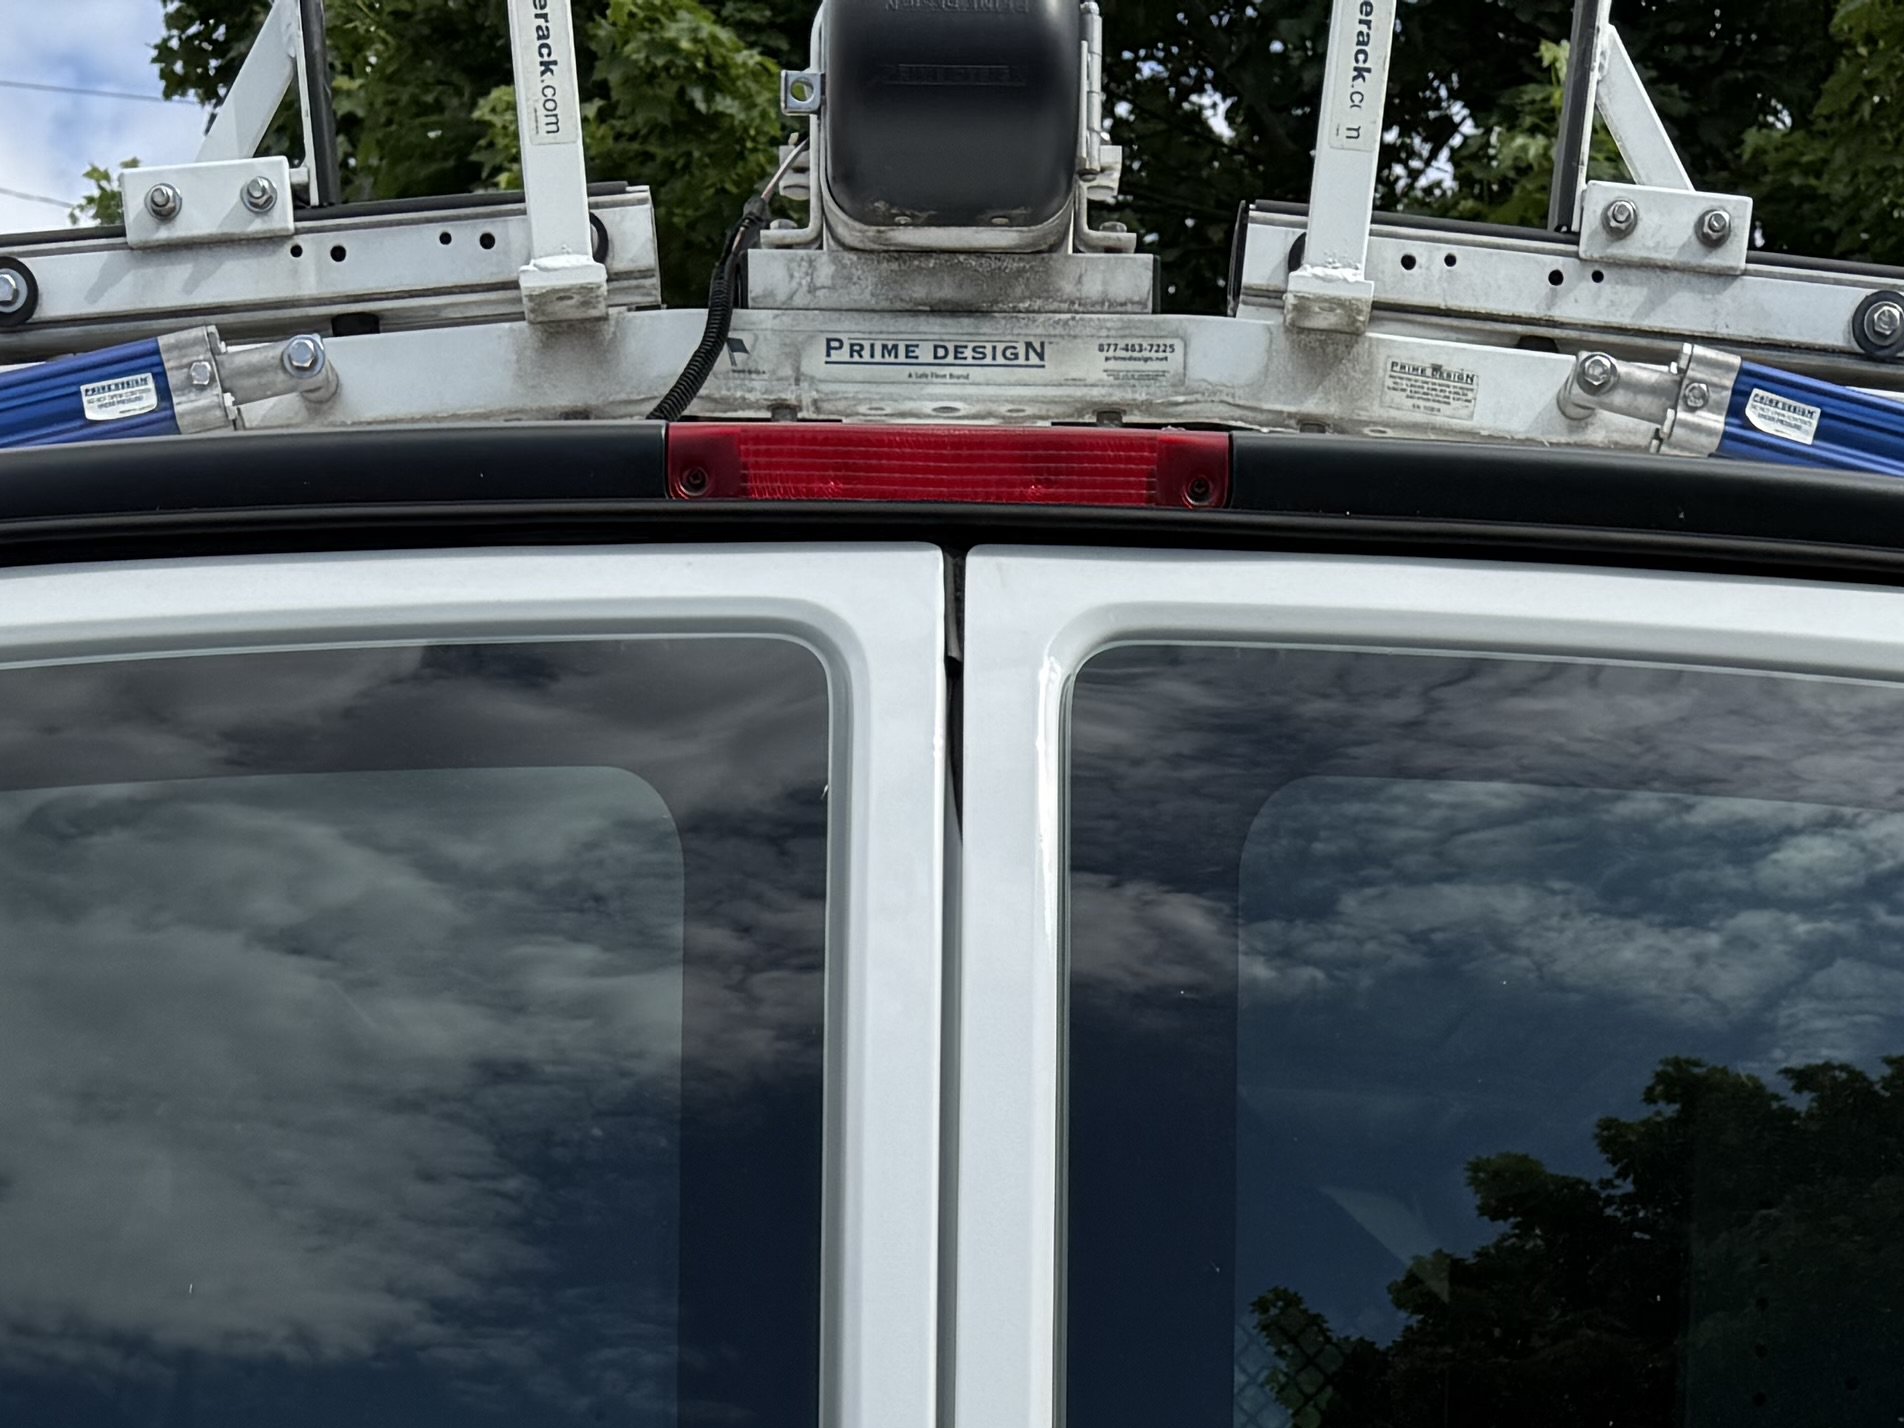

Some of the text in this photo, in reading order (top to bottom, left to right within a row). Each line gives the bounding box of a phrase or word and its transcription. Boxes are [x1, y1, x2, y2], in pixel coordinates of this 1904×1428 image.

[1346, 0, 1374, 139] erack.cm
[825, 337, 1046, 362] PRIME DESIGN
